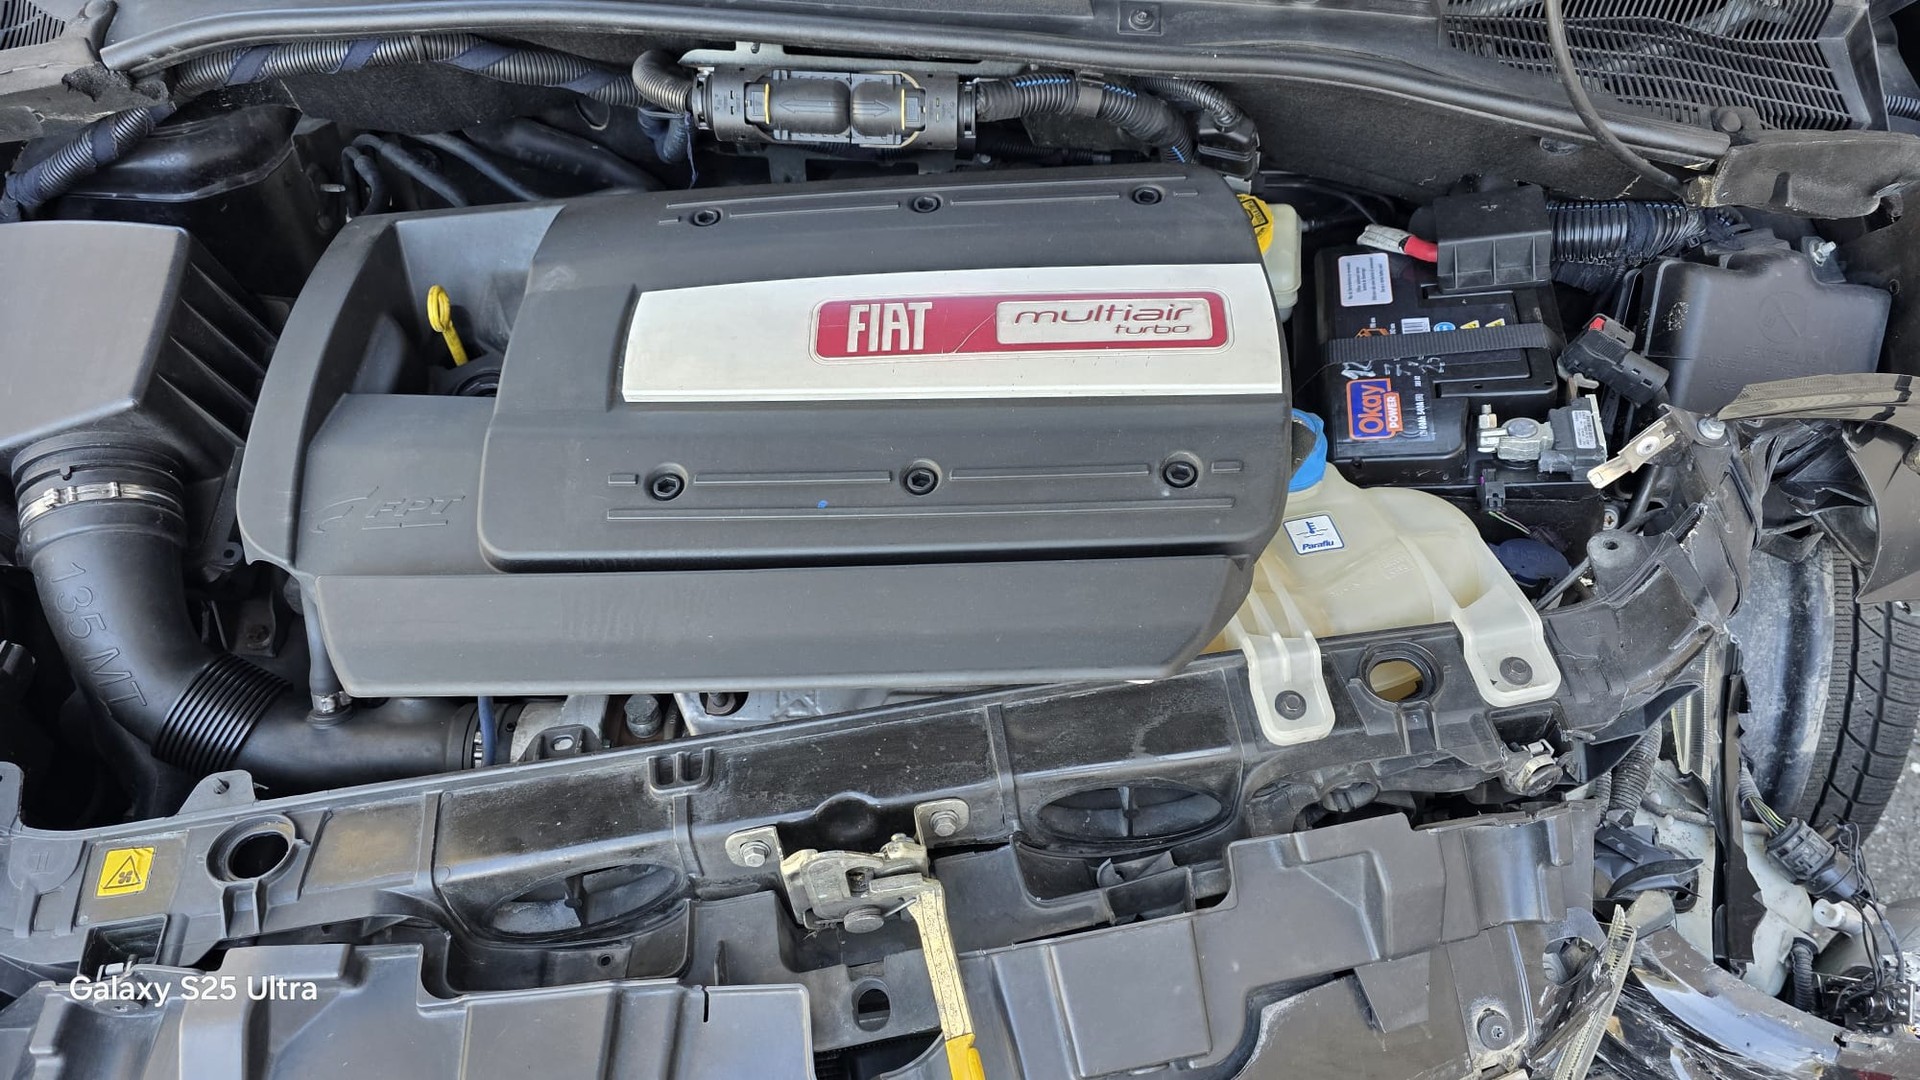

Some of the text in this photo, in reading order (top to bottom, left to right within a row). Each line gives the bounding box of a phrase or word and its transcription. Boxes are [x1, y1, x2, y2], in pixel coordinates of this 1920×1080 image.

[846, 302, 933, 353] FIAT
[1014, 303, 1194, 325] multiair
[1114, 323, 1192, 335] turbo
[1357, 384, 1386, 434] Okay
[1386, 396, 1400, 429] POWER
[365, 495, 466, 519] FPT
[1302, 540, 1334, 550] Paraflu
[51, 562, 148, 707] 135 MT
